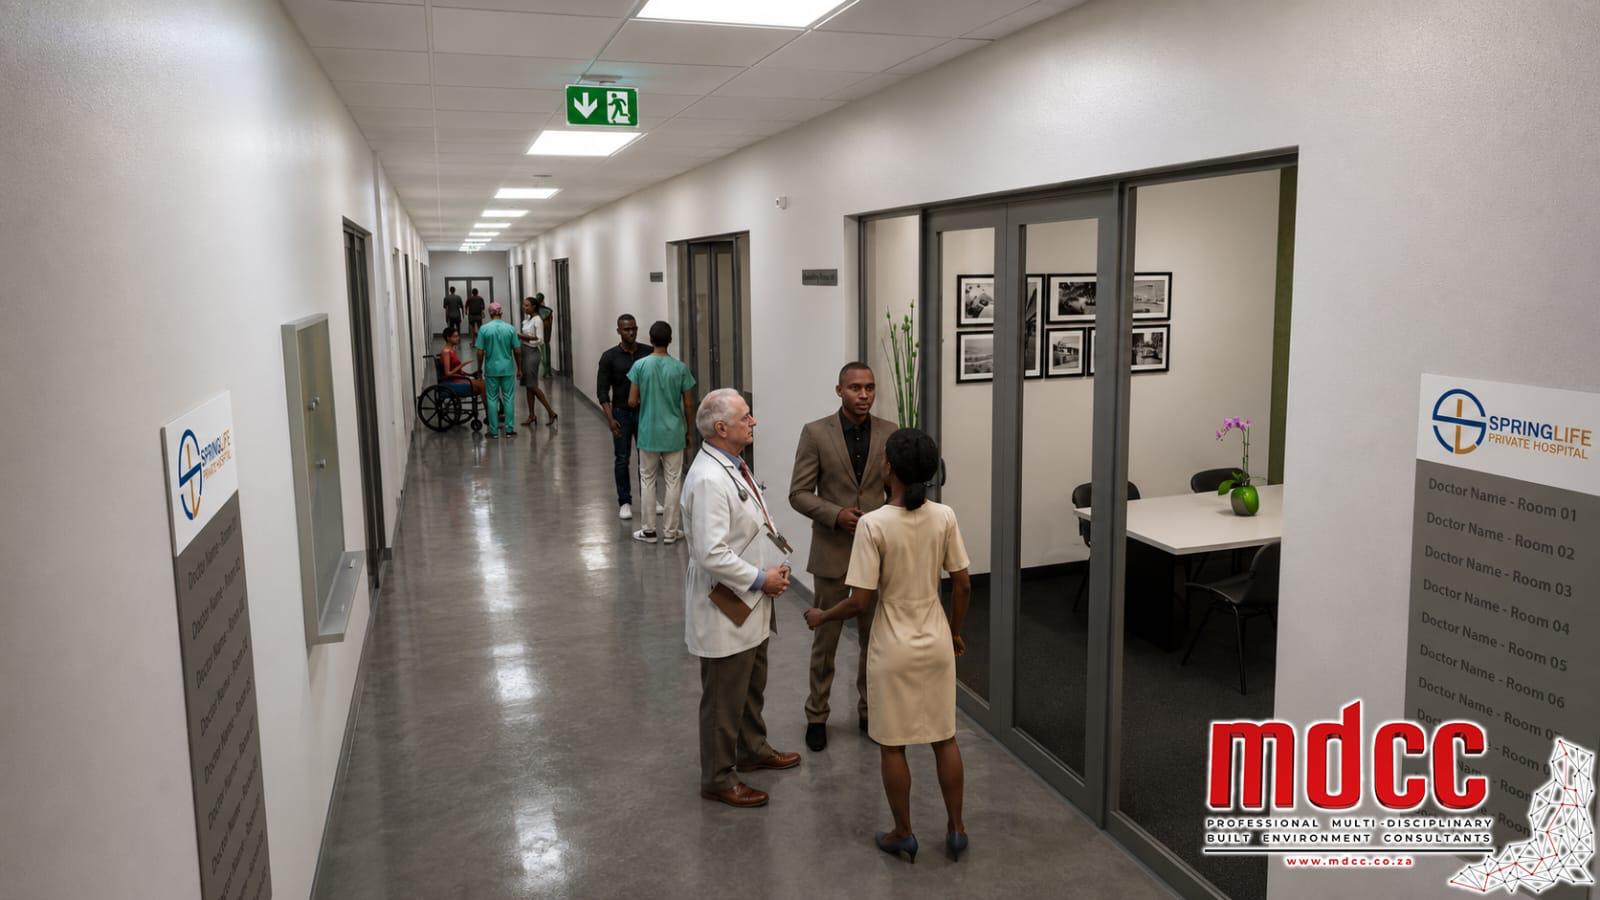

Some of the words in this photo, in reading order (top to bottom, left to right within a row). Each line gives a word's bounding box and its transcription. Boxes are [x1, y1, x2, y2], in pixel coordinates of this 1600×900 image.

[1488, 433, 1530, 450] PRIVATE
[1533, 440, 1589, 460] HOSPITAL
[1489, 415, 1592, 447] SPRINGLIFE
[1428, 477, 1468, 496] Doctor
[1470, 487, 1506, 506] Name
[1517, 497, 1557, 518] Room
[1560, 507, 1577, 522] 01
[1426, 512, 1466, 531] Doctor
[1468, 522, 1504, 542] Name
[1515, 533, 1554, 556] Room
[1557, 545, 1575, 560] 02
[1424, 545, 1464, 567] Doctor
[1466, 557, 1502, 578] Name
[1512, 570, 1551, 593] Room
[1555, 582, 1572, 598] 03
[1423, 578, 1462, 600] Doctor
[1464, 591, 1500, 613] Name
[1510, 606, 1549, 629] Room
[1552, 619, 1570, 635] 04
[1421, 611, 1459, 633] Doctor
[1462, 625, 1498, 648] Name
[1508, 641, 1546, 665] Room
[1550, 656, 1567, 672] 05
[1420, 644, 1458, 667] Doctor
[1460, 659, 1496, 682] Name
[1506, 676, 1544, 701] Room
[1547, 692, 1565, 709] 06
[1418, 676, 1456, 700] Doctor
[1458, 692, 1493, 716] Name
[1504, 711, 1541, 736] Room
[1417, 708, 1442, 724] Doct
[1502, 746, 1539, 771] Room
